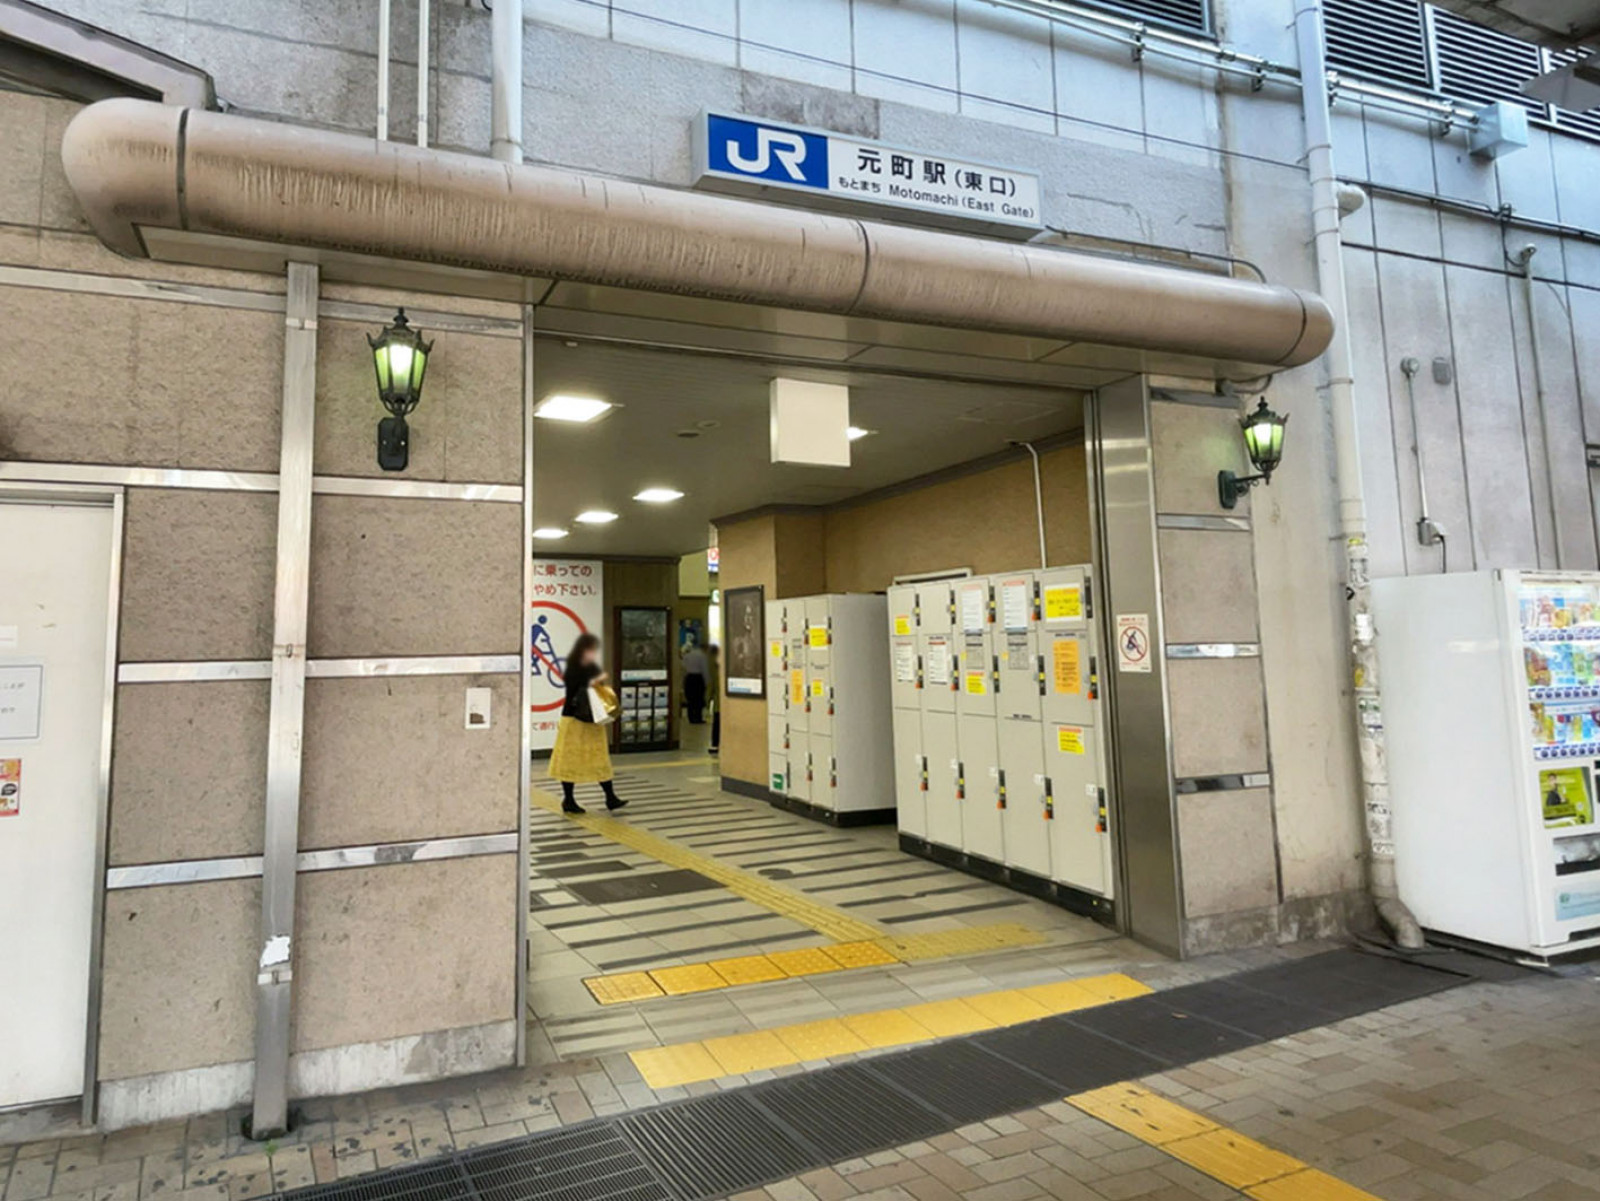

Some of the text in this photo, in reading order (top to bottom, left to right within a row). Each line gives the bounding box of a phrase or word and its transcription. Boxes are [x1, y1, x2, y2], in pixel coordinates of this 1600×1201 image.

[726, 127, 807, 182] JR
[838, 176, 882, 194] もとまち
[1001, 202, 1035, 219] Gate)
